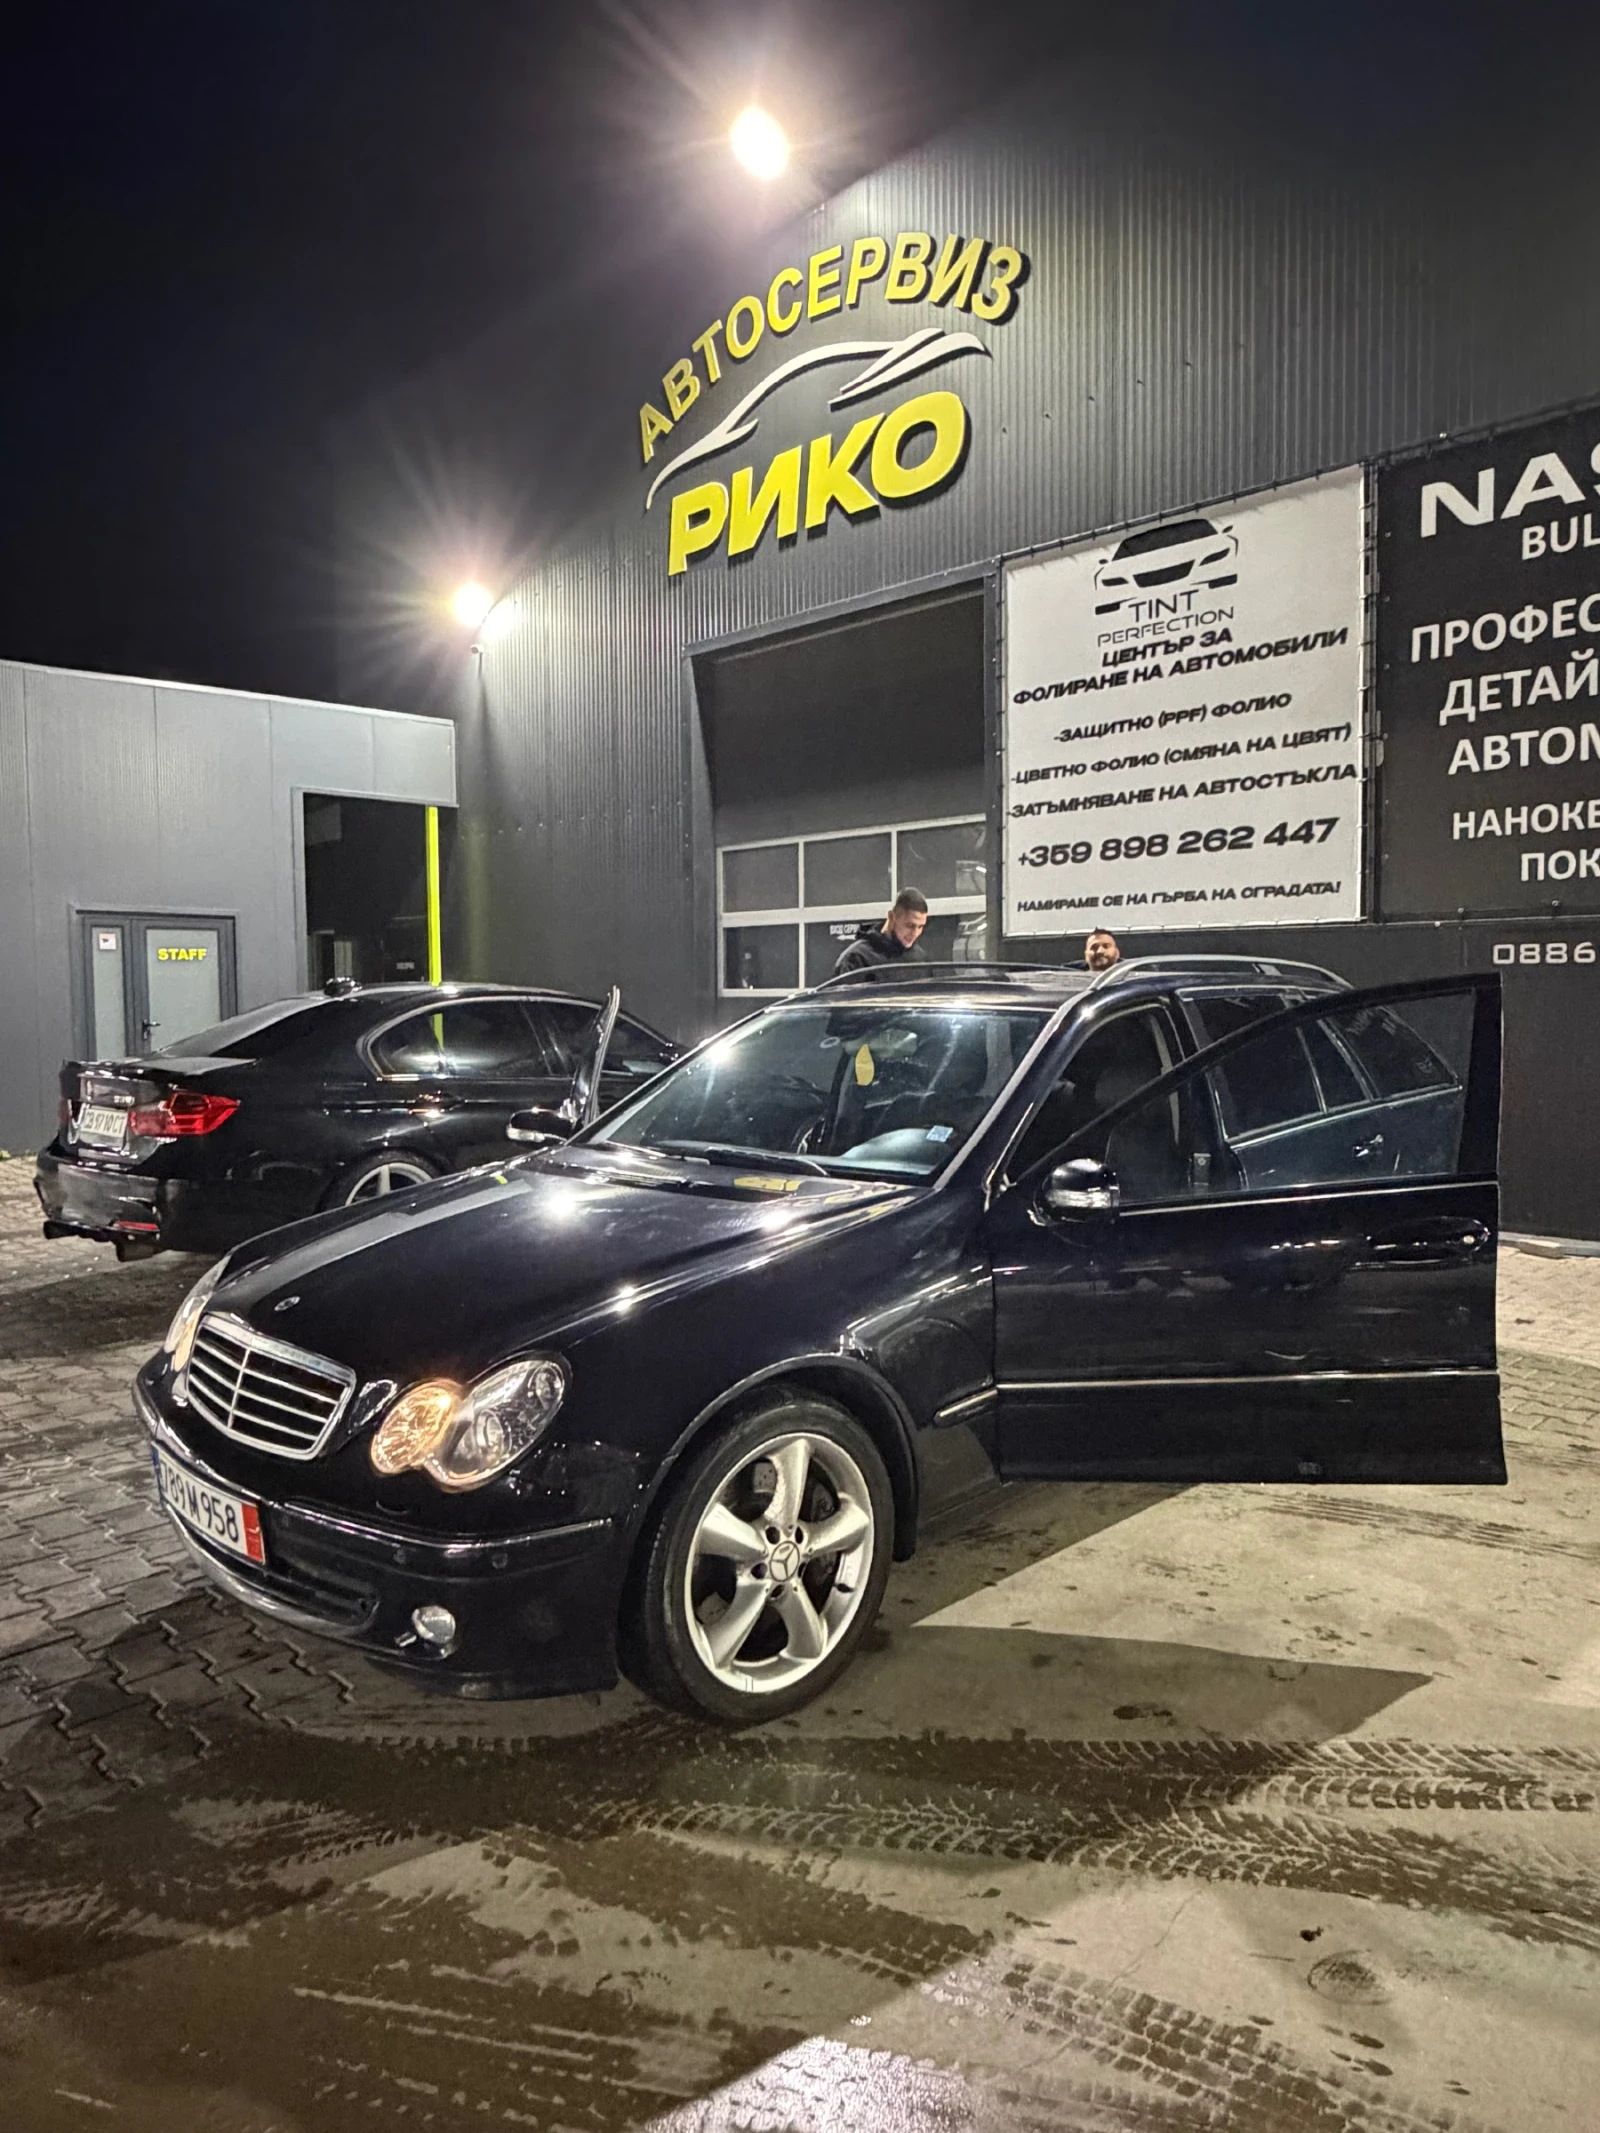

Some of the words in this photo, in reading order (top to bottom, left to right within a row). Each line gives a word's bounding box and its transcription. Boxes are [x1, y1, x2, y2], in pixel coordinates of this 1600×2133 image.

[639, 232, 1024, 464] АВТОСЕРВИЗ
[668, 391, 966, 576] РИКО
[1420, 442, 1600, 538] NA
[1522, 513, 1600, 560] BUL
[1097, 606, 1234, 647] PERFECTION
[1128, 589, 1199, 622] TINT
[1102, 635, 1195, 667] ЦЕНТЪР
[1199, 628, 1233, 648] ЗА
[1411, 594, 1600, 662] ПРОФЕС
[1013, 670, 1129, 704] ФОЛИРАНЕ
[1132, 664, 1163, 684] НА
[1168, 627, 1348, 676] АВТОМОБИЛИ
[1439, 648, 1600, 726] ДЕТАЙ
[1158, 704, 1207, 728] (PPF)
[1211, 693, 1293, 717] ФОЛИО
[1090, 752, 1160, 772] ФОЛИО
[1164, 741, 1242, 765] (СМЯНА
[1246, 736, 1277, 753] НА
[1281, 722, 1352, 748] ЦВЯТ)
[1159, 784, 1189, 801] НА
[1193, 763, 1358, 797] АВТОСТЪКЛА
[1018, 841, 1093, 867] +359
[1099, 833, 1169, 862] 898
[1176, 825, 1256, 854] 262
[1263, 817, 1340, 846] 447
[1521, 849, 1600, 881] ПОК
[1017, 896, 1100, 912] НАМИРАМЕ
[1102, 894, 1124, 907] СЕ
[1126, 893, 1148, 905] НА
[1151, 890, 1208, 904] ГЪРБА
[1211, 888, 1237, 901] НА
[1240, 881, 1341, 899] ОГРАДАТА!
[157, 948, 207, 961] STAFF
[1493, 942, 1596, 965] 0886
